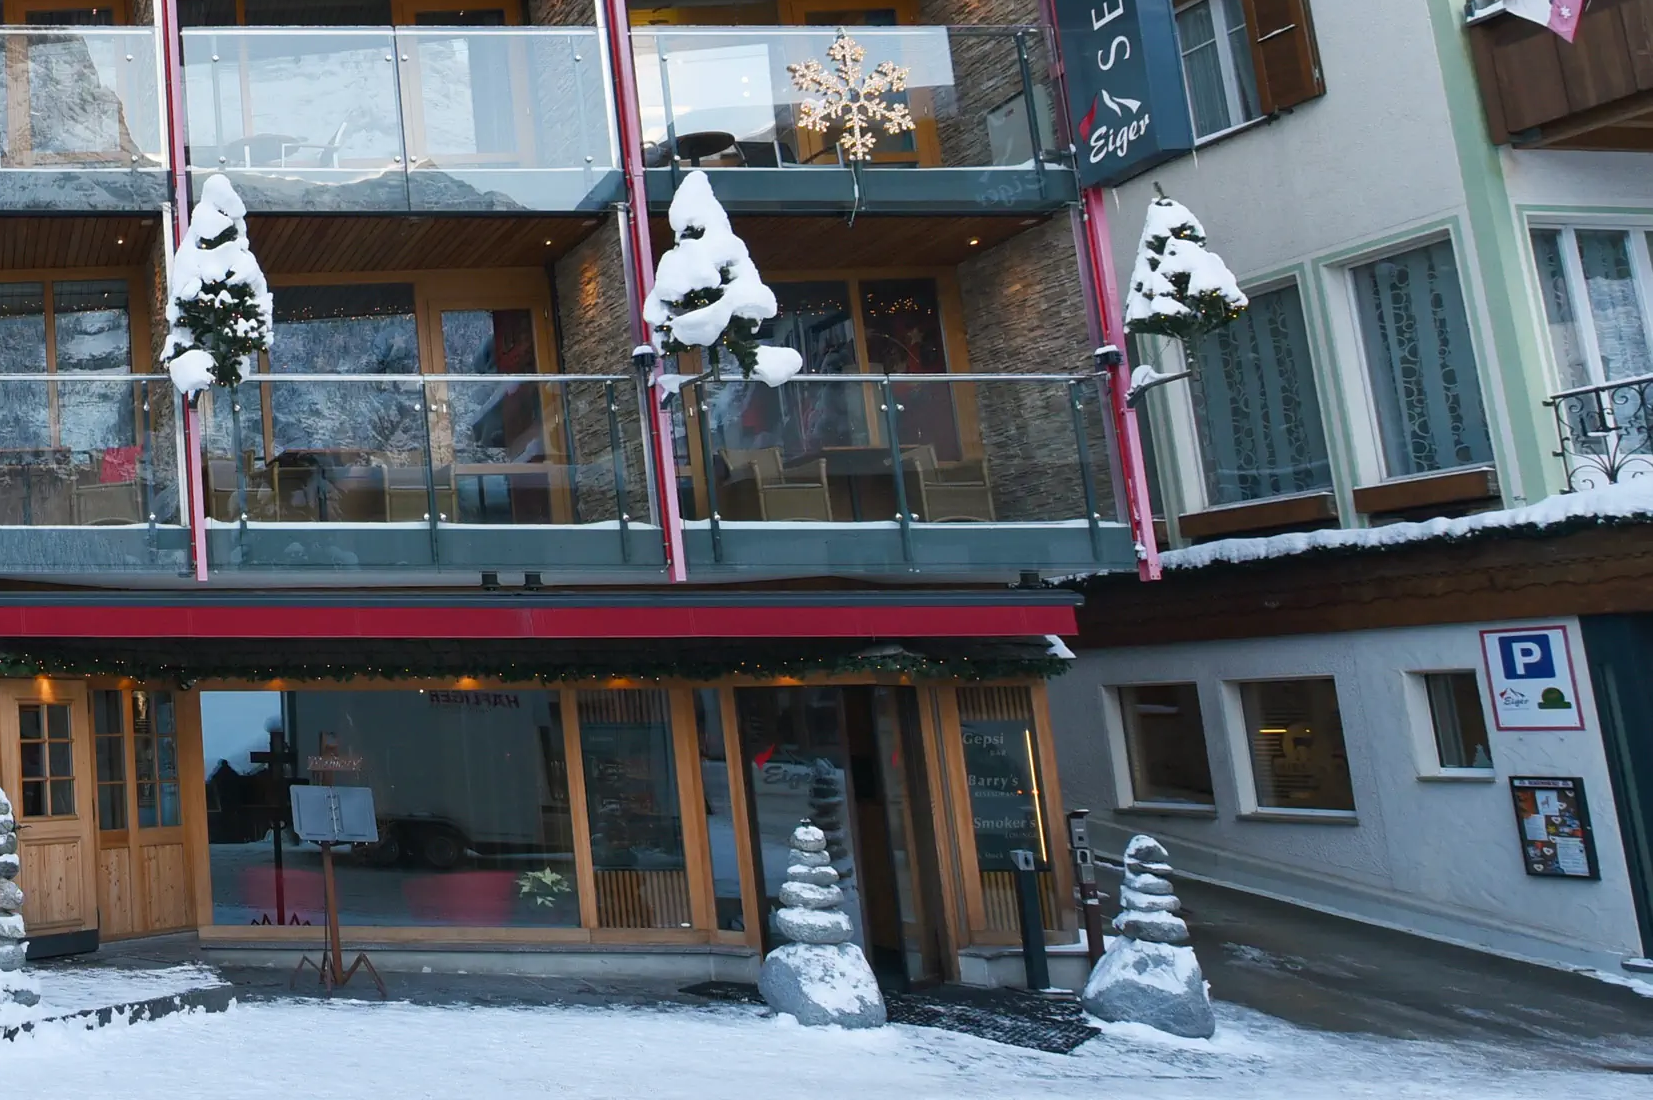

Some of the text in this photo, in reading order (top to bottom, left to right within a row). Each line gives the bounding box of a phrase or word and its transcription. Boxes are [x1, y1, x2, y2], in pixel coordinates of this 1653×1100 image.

[1088, 113, 1151, 164] Eiger
[1511, 642, 1542, 675] P
[962, 732, 1004, 747] Gepsi
[968, 774, 1019, 790] Barry's
[973, 817, 1036, 829] Smoker's
